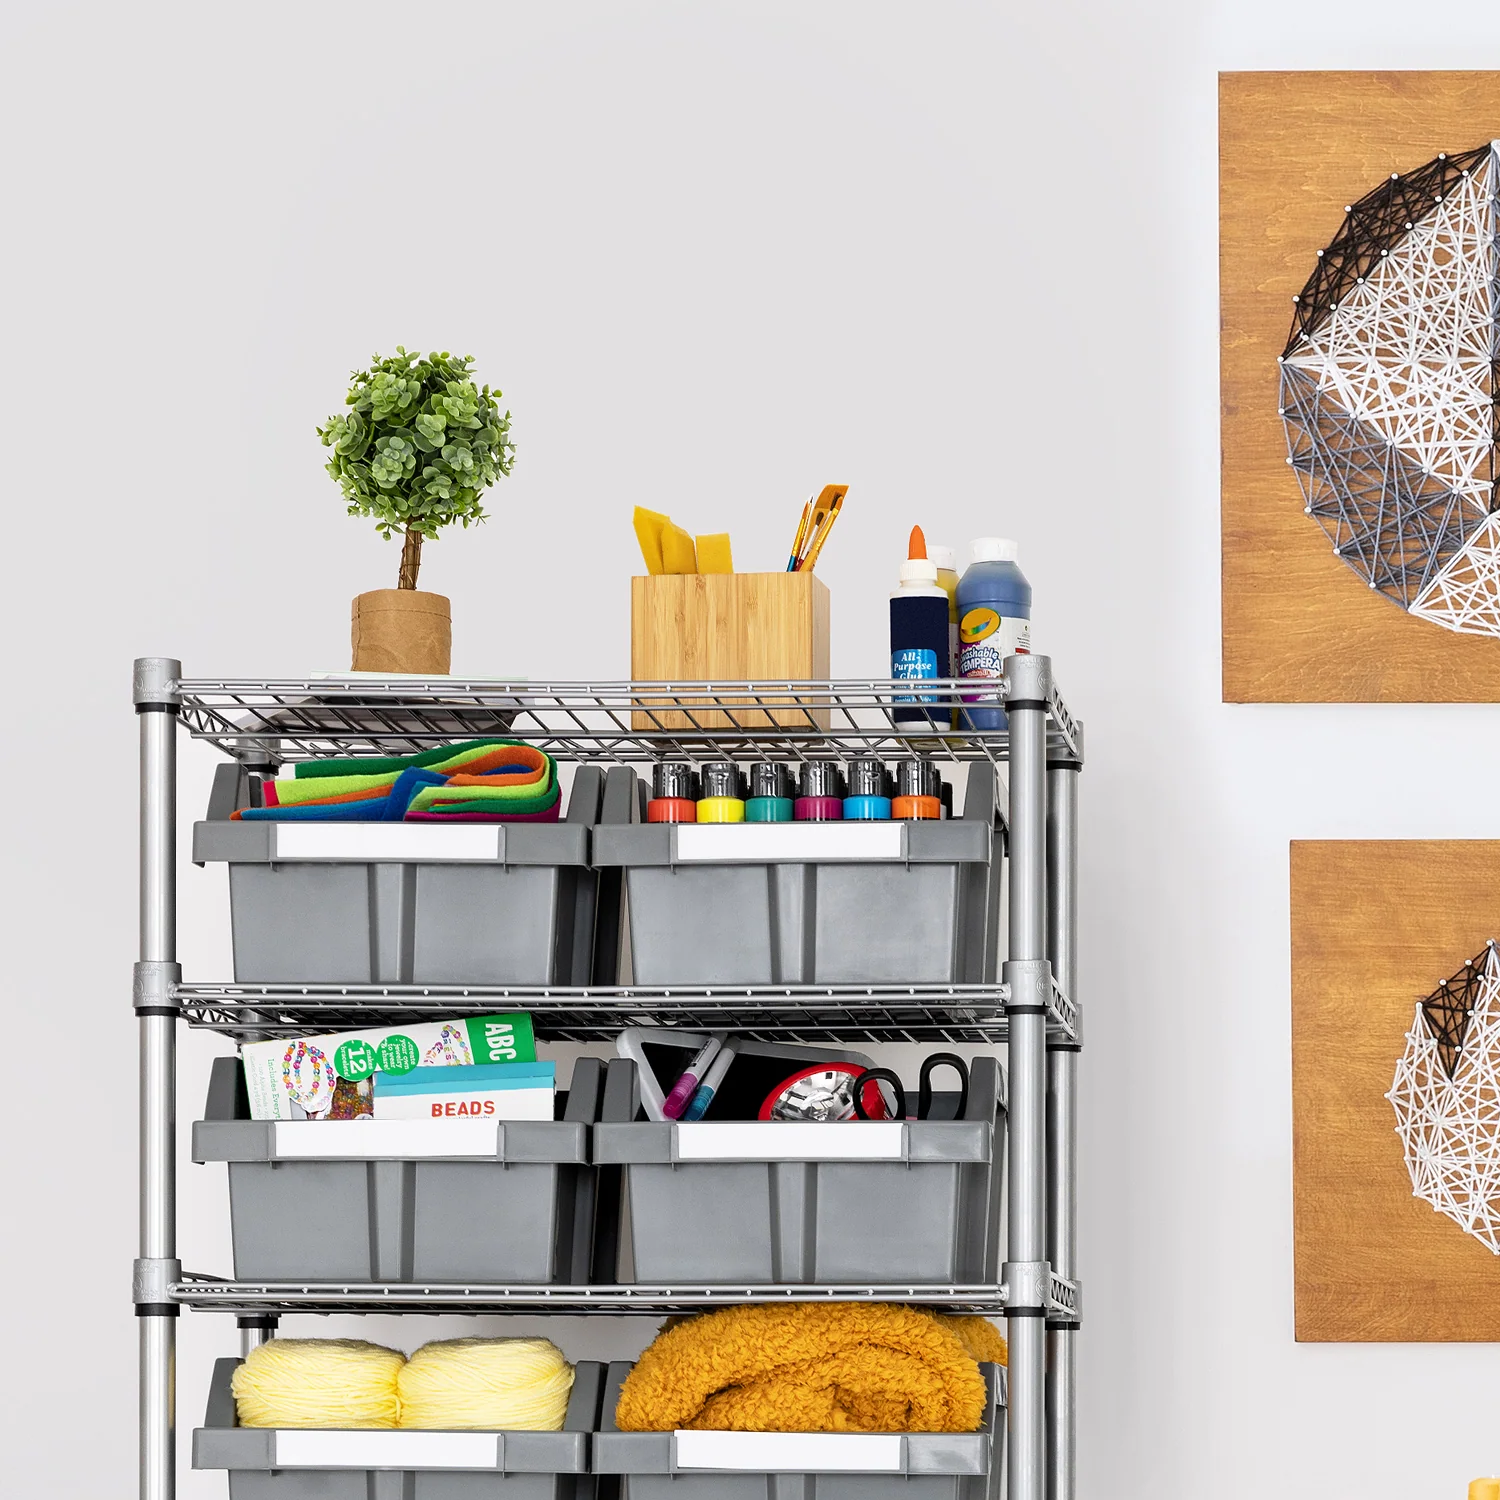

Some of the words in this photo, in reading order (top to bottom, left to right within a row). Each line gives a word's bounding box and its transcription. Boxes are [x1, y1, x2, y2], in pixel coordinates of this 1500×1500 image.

[894, 662, 932, 672] Purpose
[961, 658, 1001, 673] TEMPERA
[387, 1043, 393, 1051] to
[400, 1039, 408, 1055] your
[485, 1023, 517, 1061] ABC
[340, 1046, 350, 1077] bracelets!
[348, 1047, 367, 1075] 12
[366, 1049, 374, 1070] makes
[381, 1049, 391, 1071] share!
[393, 1043, 404, 1069] jewelry
[408, 1043, 416, 1065] create
[267, 1058, 278, 1092] Includes
[272, 1093, 281, 1119] Everyt
[431, 1100, 495, 1118] BEADS
